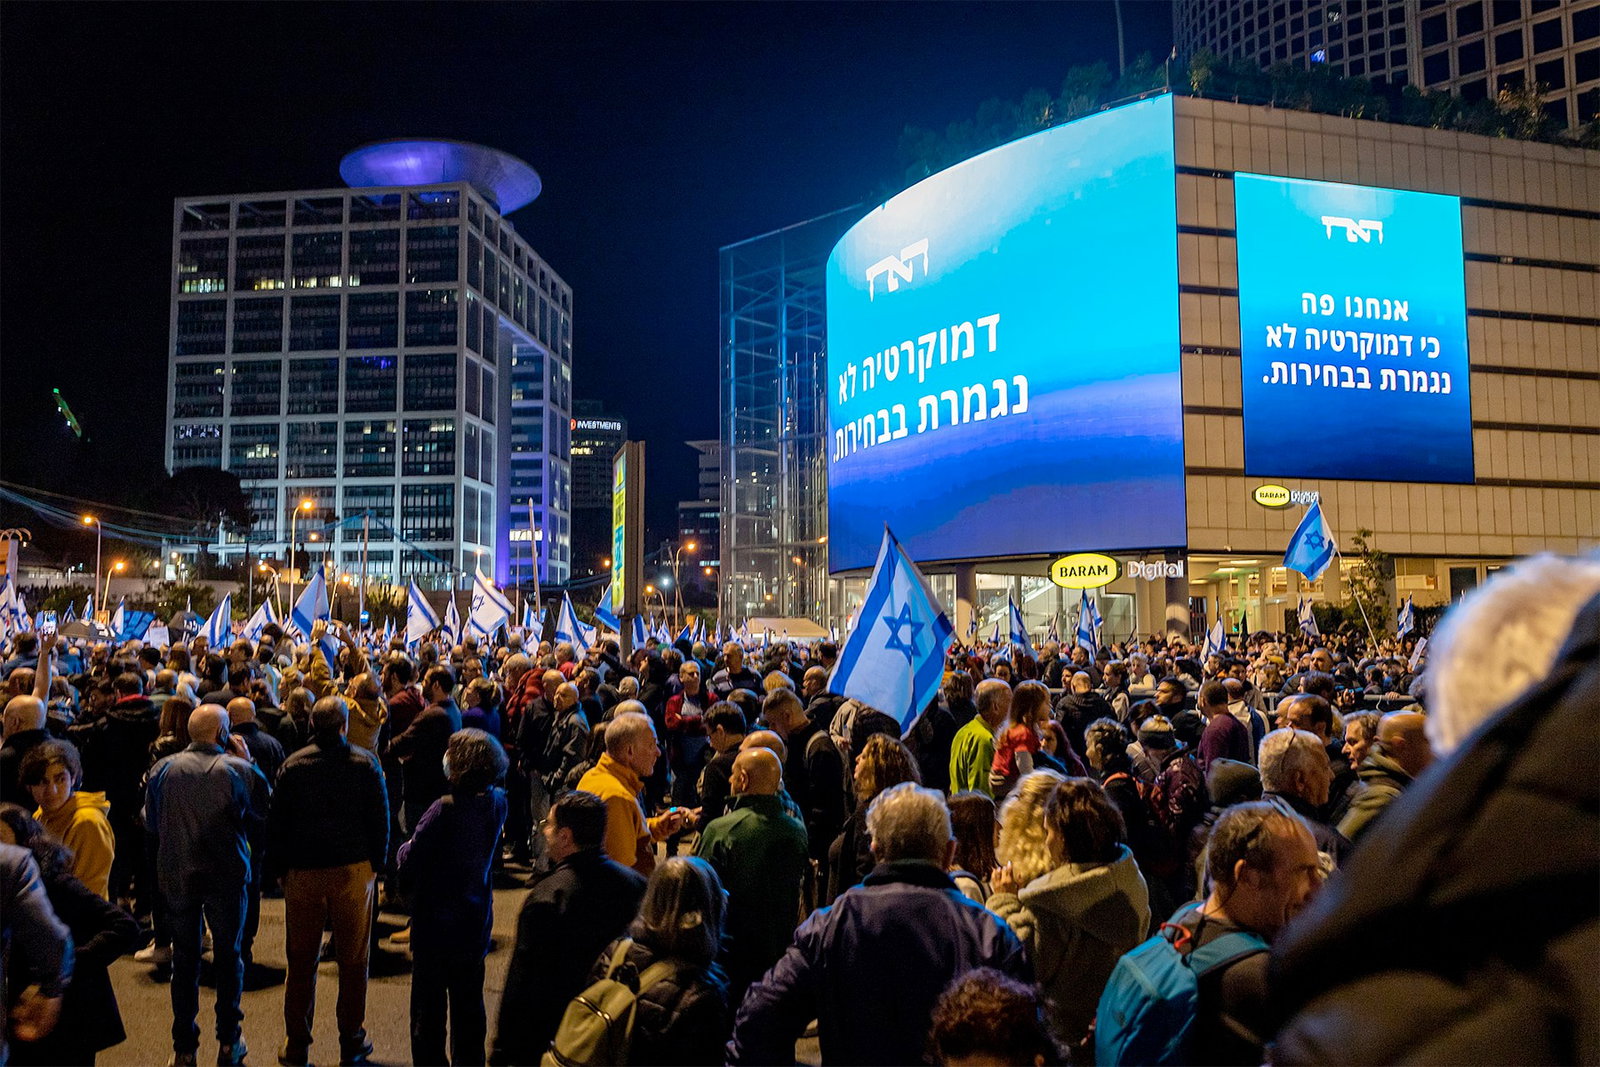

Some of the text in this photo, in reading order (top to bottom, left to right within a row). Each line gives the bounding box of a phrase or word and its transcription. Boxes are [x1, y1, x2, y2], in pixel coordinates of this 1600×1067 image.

[1301, 292, 1409, 322] אנחנו פה
[1265, 322, 1441, 361] כי דמוקרטיה לא
[838, 313, 1000, 406] דמוקרטיה לא
[1262, 361, 1451, 394] נגמרת בבחירות.
[577, 420, 621, 431] INVESTMENTS
[832, 374, 1029, 464] נגמרת בבחירות.
[1059, 559, 1184, 582] BARAM Digital
